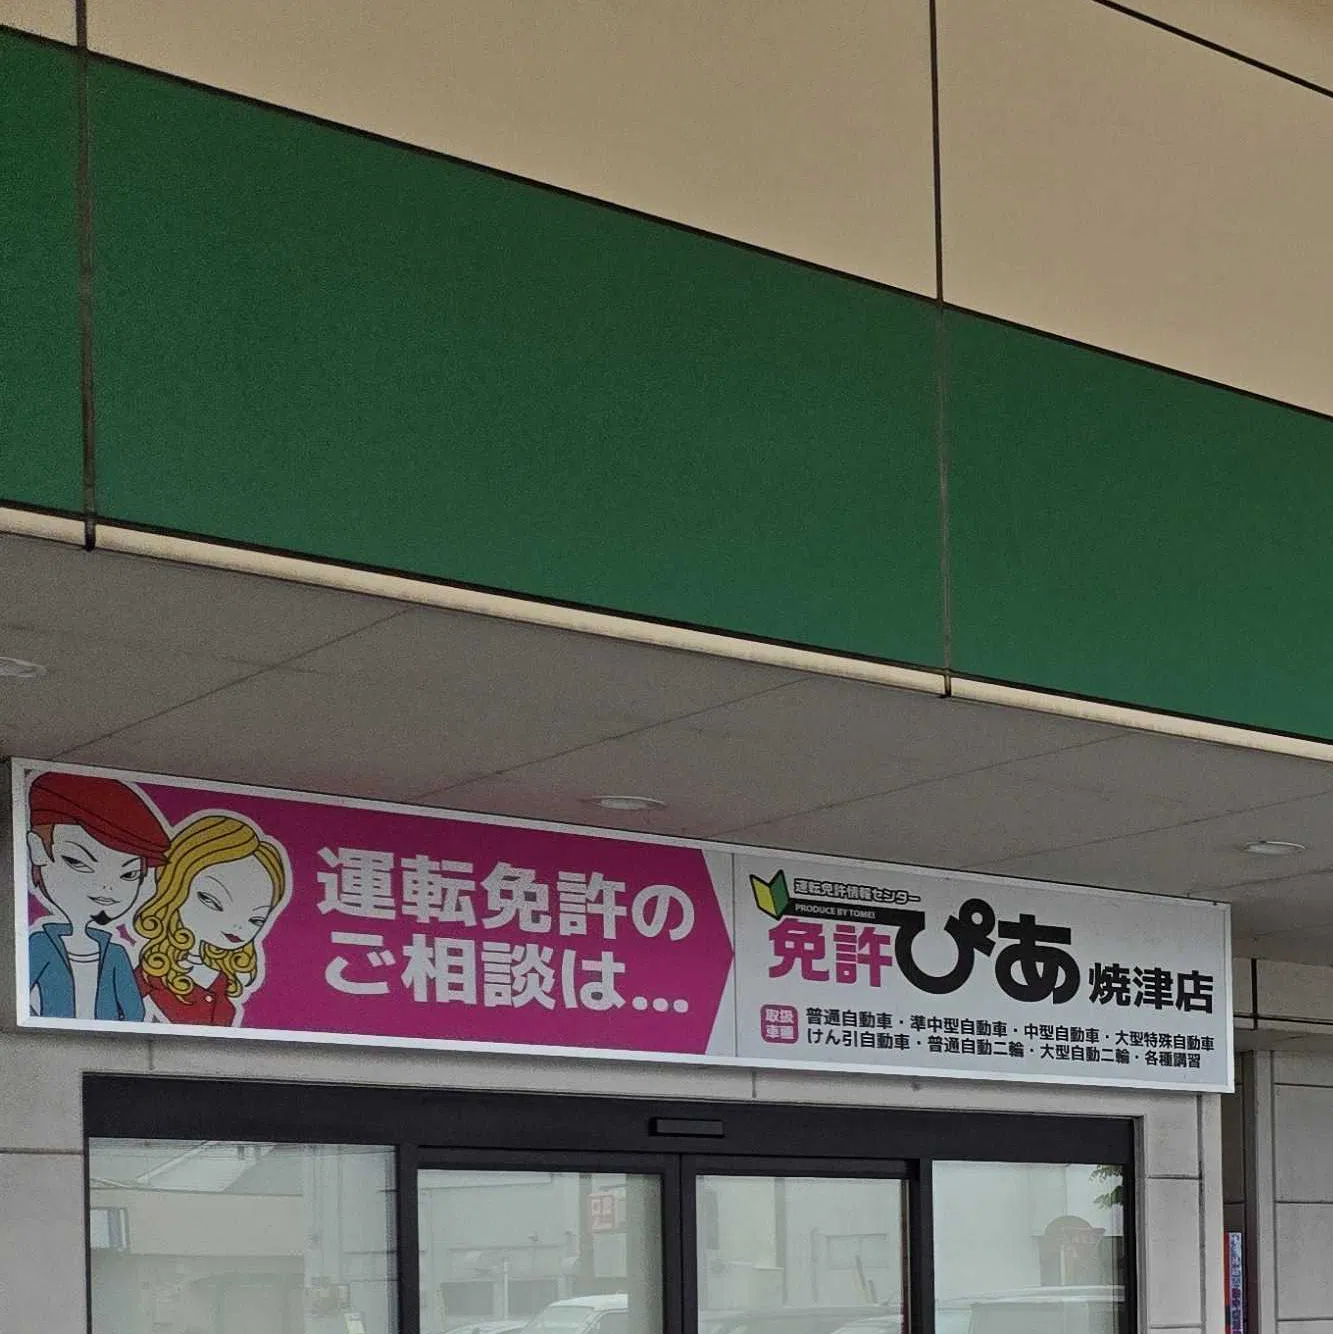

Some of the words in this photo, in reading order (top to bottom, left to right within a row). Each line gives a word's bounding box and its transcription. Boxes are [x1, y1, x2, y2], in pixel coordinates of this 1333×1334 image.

[316, 846, 696, 942] 運転免許の
[794, 877, 922, 904] 運転免許情報センター
[795, 903, 836, 916] PRODUCE
[837, 907, 848, 917] BY
[849, 908, 876, 919] TOMEI
[1088, 963, 1214, 1014] 焼津店
